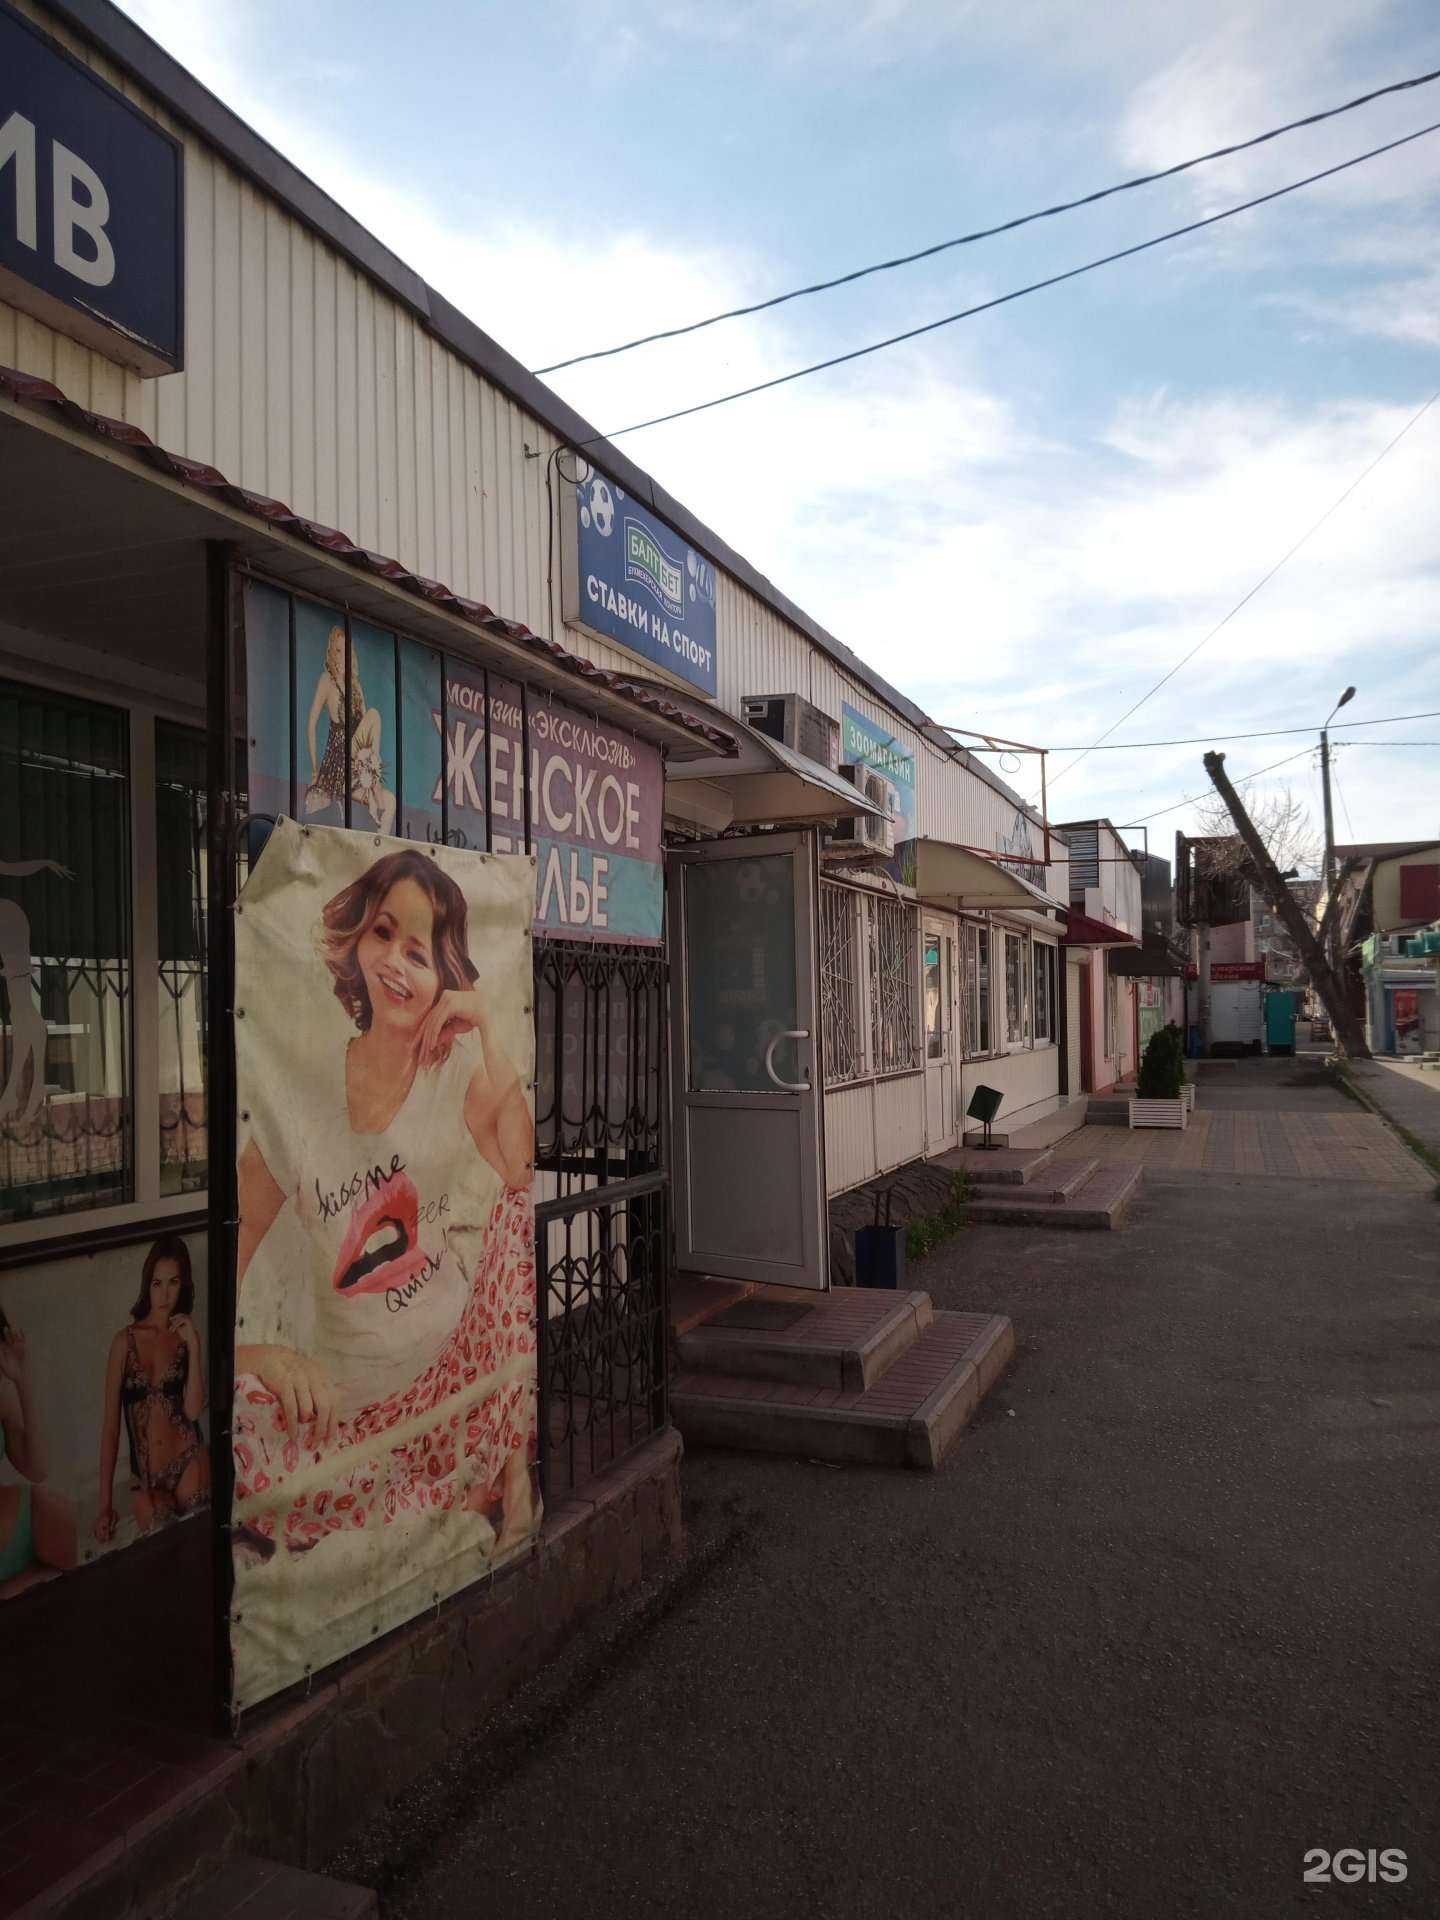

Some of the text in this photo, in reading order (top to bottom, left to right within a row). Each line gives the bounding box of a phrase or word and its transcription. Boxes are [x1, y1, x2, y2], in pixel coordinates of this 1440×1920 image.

[587, 574, 712, 673] СТАВКИ НА СПОРТ
[432, 710, 641, 849] ЖЕНСКОЕ
[849, 725, 911, 784] ЗООМАГАЗИН
[491, 833, 609, 927] ЛЬЕ
